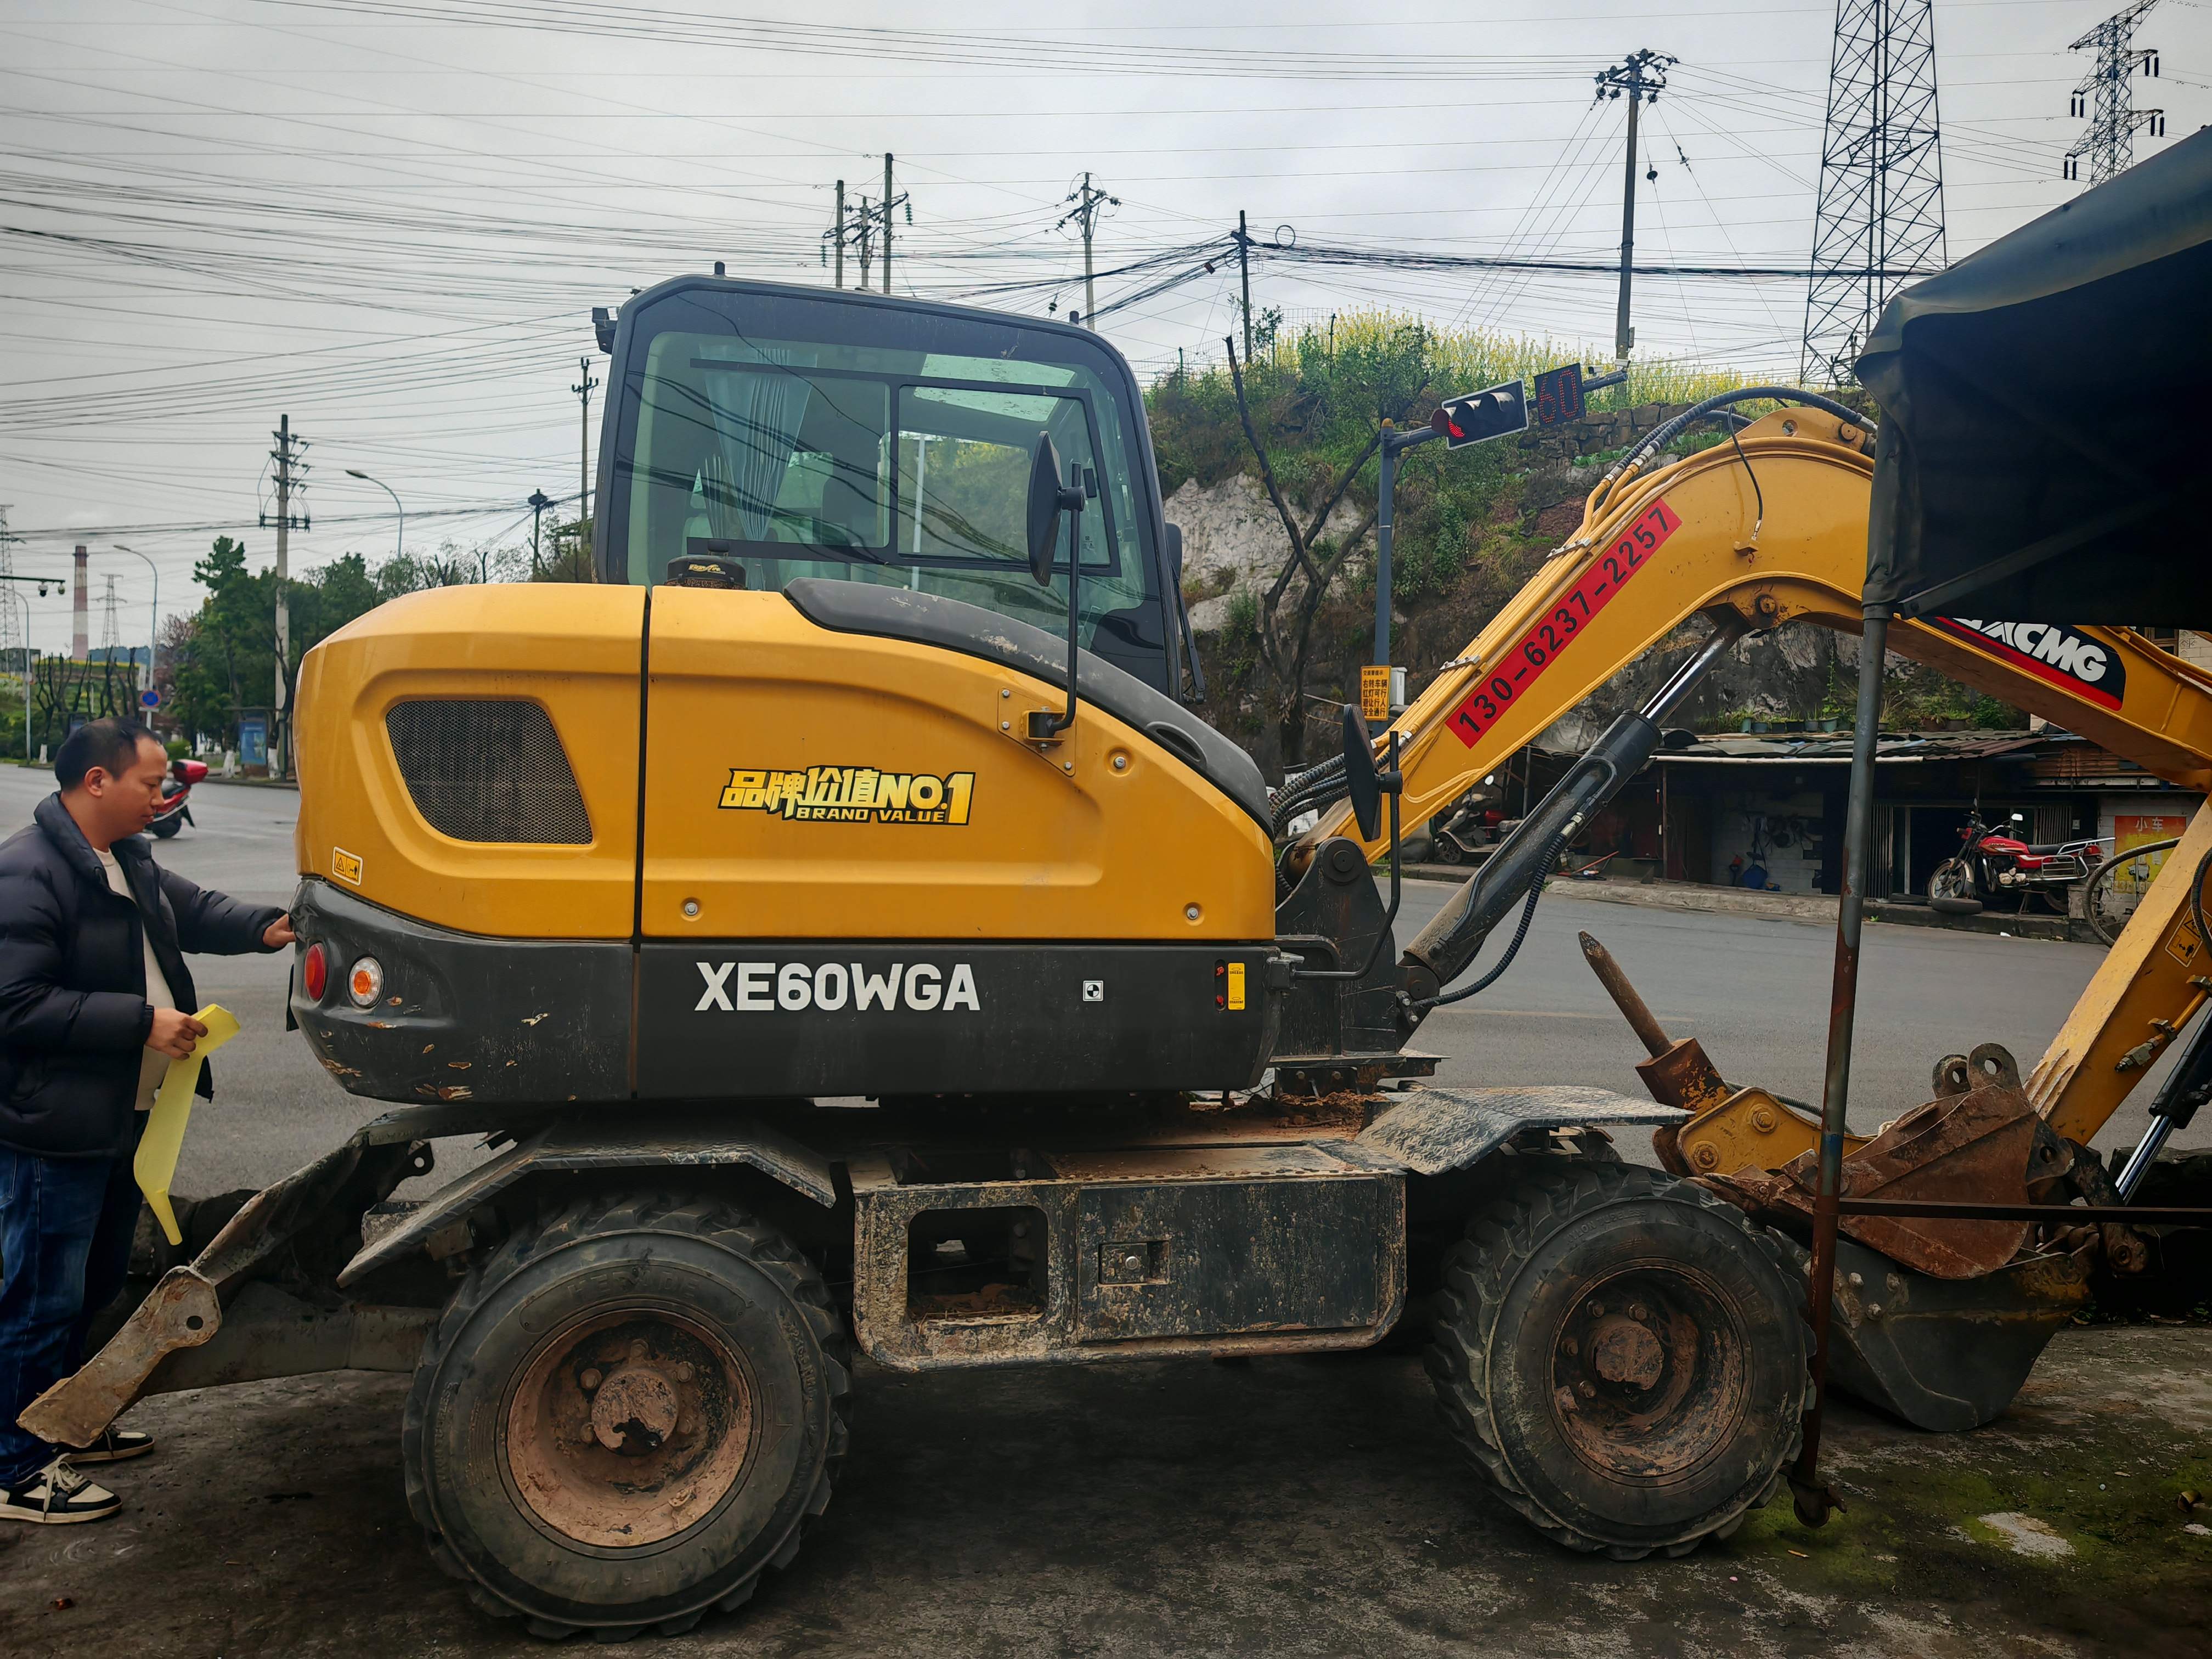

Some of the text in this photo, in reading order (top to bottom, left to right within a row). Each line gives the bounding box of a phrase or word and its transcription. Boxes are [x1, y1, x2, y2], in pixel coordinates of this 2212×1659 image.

[1538, 368, 1579, 424] 60
[1459, 507, 1669, 732] 130-6237-2257
[1363, 679, 1387, 689] 右转车辆
[1363, 689, 1387, 698] 红灯可行
[796, 807, 945, 822] BRAND VALUE
[2135, 816, 2164, 832] 小车
[694, 962, 980, 1011] XE60WGA
